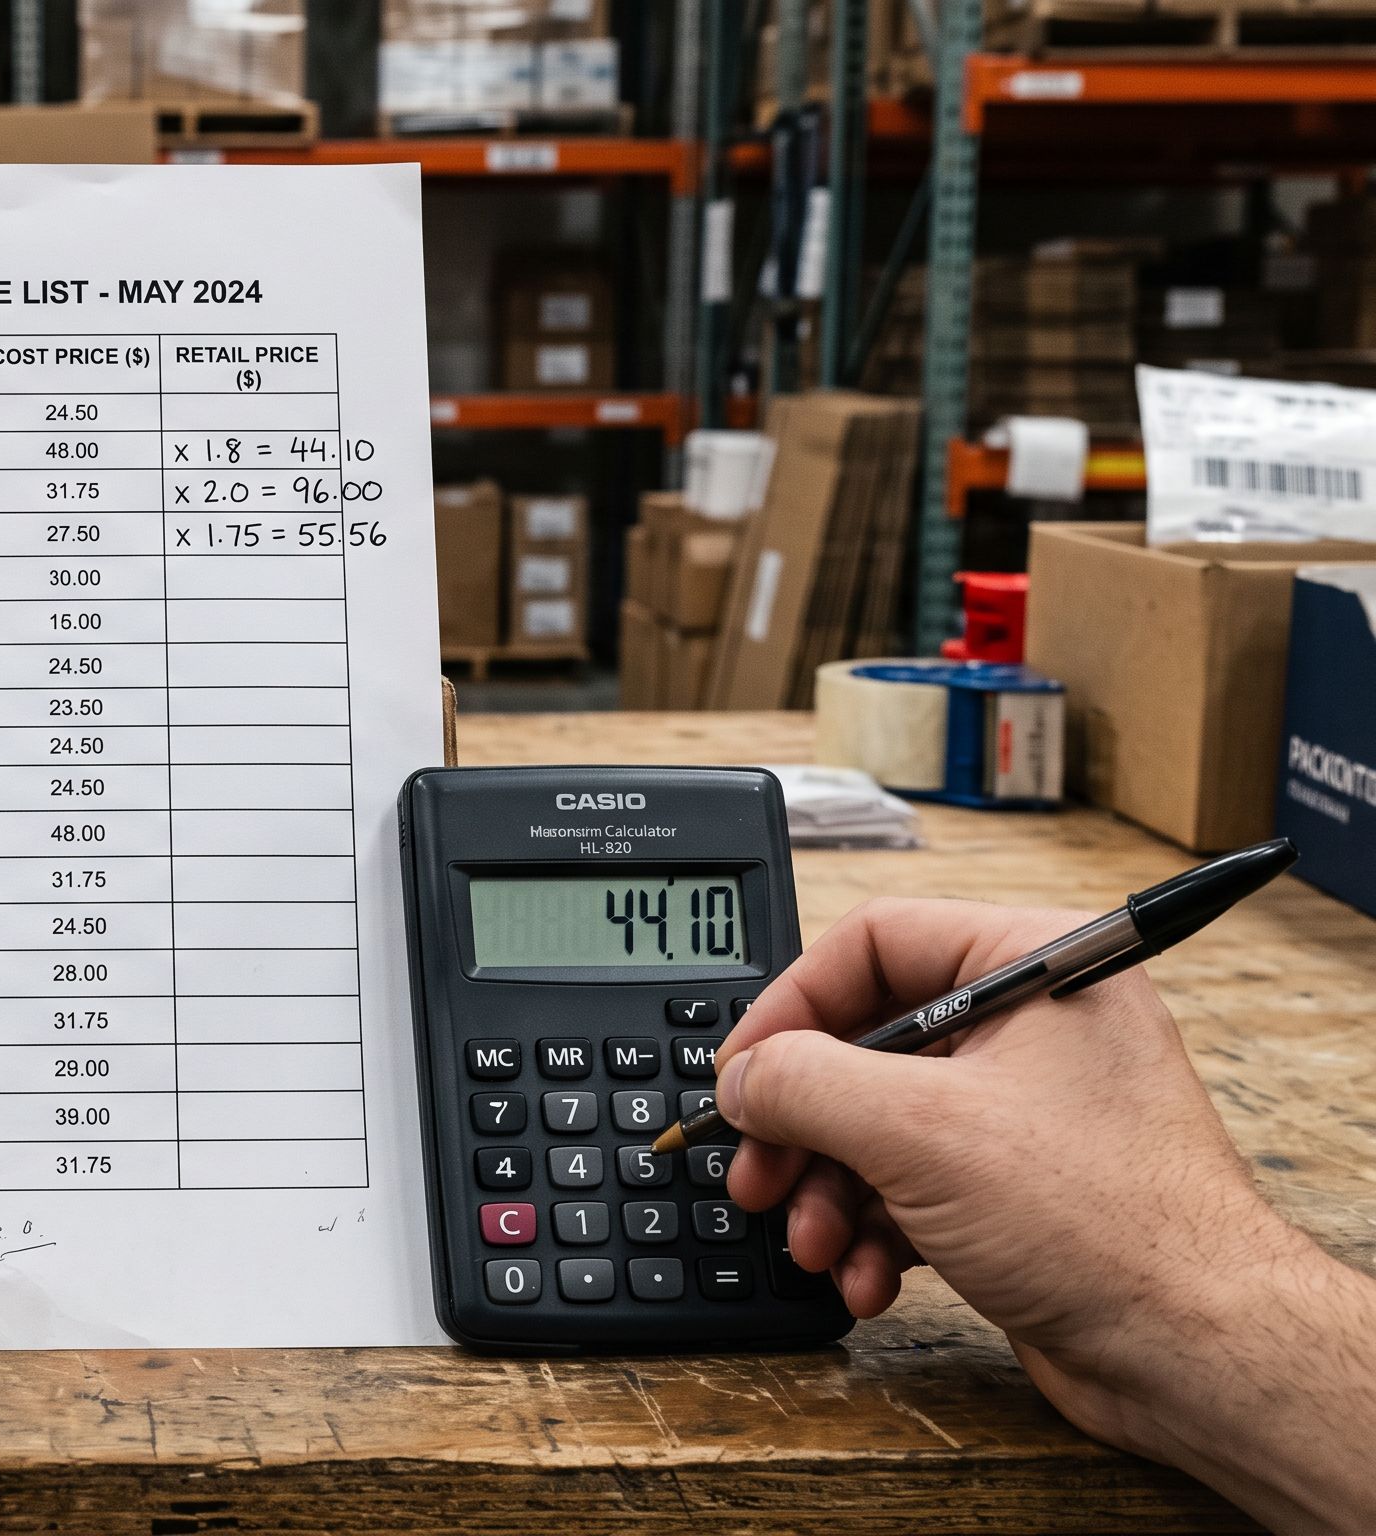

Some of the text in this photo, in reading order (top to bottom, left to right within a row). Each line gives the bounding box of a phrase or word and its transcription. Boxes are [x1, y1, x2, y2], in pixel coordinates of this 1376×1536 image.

[23, 279, 89, 305] LIST
[118, 279, 185, 304] MAY
[193, 279, 263, 304] 2024
[55, 347, 119, 365] PRICE
[125, 346, 150, 369] ($)
[176, 346, 319, 363] RETAIL PRICE
[236, 369, 262, 391] ($)
[45, 404, 98, 421] 24.50
[45, 441, 99, 459] 48.00
[206, 437, 242, 464] 1.8
[256, 443, 273, 456] =
[290, 436, 375, 463] 44.10
[46, 482, 100, 500] 31.75
[203, 479, 249, 504] 2.0
[261, 485, 277, 497] =
[292, 476, 383, 504] 96.00
[46, 525, 100, 542] 27.50
[208, 523, 263, 548] 1.75
[271, 528, 286, 540] =
[298, 520, 387, 547] 55.56
[49, 569, 101, 587] 30.00
[48, 657, 103, 675] 24.50
[49, 698, 103, 716] 23.50
[49, 737, 104, 755] 24.50
[50, 778, 105, 796] 24.50
[555, 793, 646, 810] CASIO
[50, 824, 106, 842] 48.00
[604, 824, 677, 838] Calculator
[580, 841, 632, 854] HL-820
[51, 870, 107, 889] 31.75
[52, 917, 107, 935] 24.50
[53, 964, 108, 982] 28.00
[932, 994, 968, 1023] BIC
[53, 1011, 109, 1030] 31.75
[476, 1048, 514, 1067] MC
[548, 1047, 585, 1066] MR
[54, 1059, 110, 1078] 29.00
[55, 1107, 110, 1126] 39.00
[561, 1098, 579, 1125] 7
[631, 1097, 650, 1123] 8
[56, 1156, 112, 1174] 31.75
[568, 1153, 587, 1179] 4
[637, 1152, 655, 1178] 5
[706, 1151, 724, 1178] 6
[499, 1210, 521, 1235] C
[575, 1209, 587, 1235] 1
[643, 1208, 662, 1234] 2
[712, 1207, 730, 1234] 3
